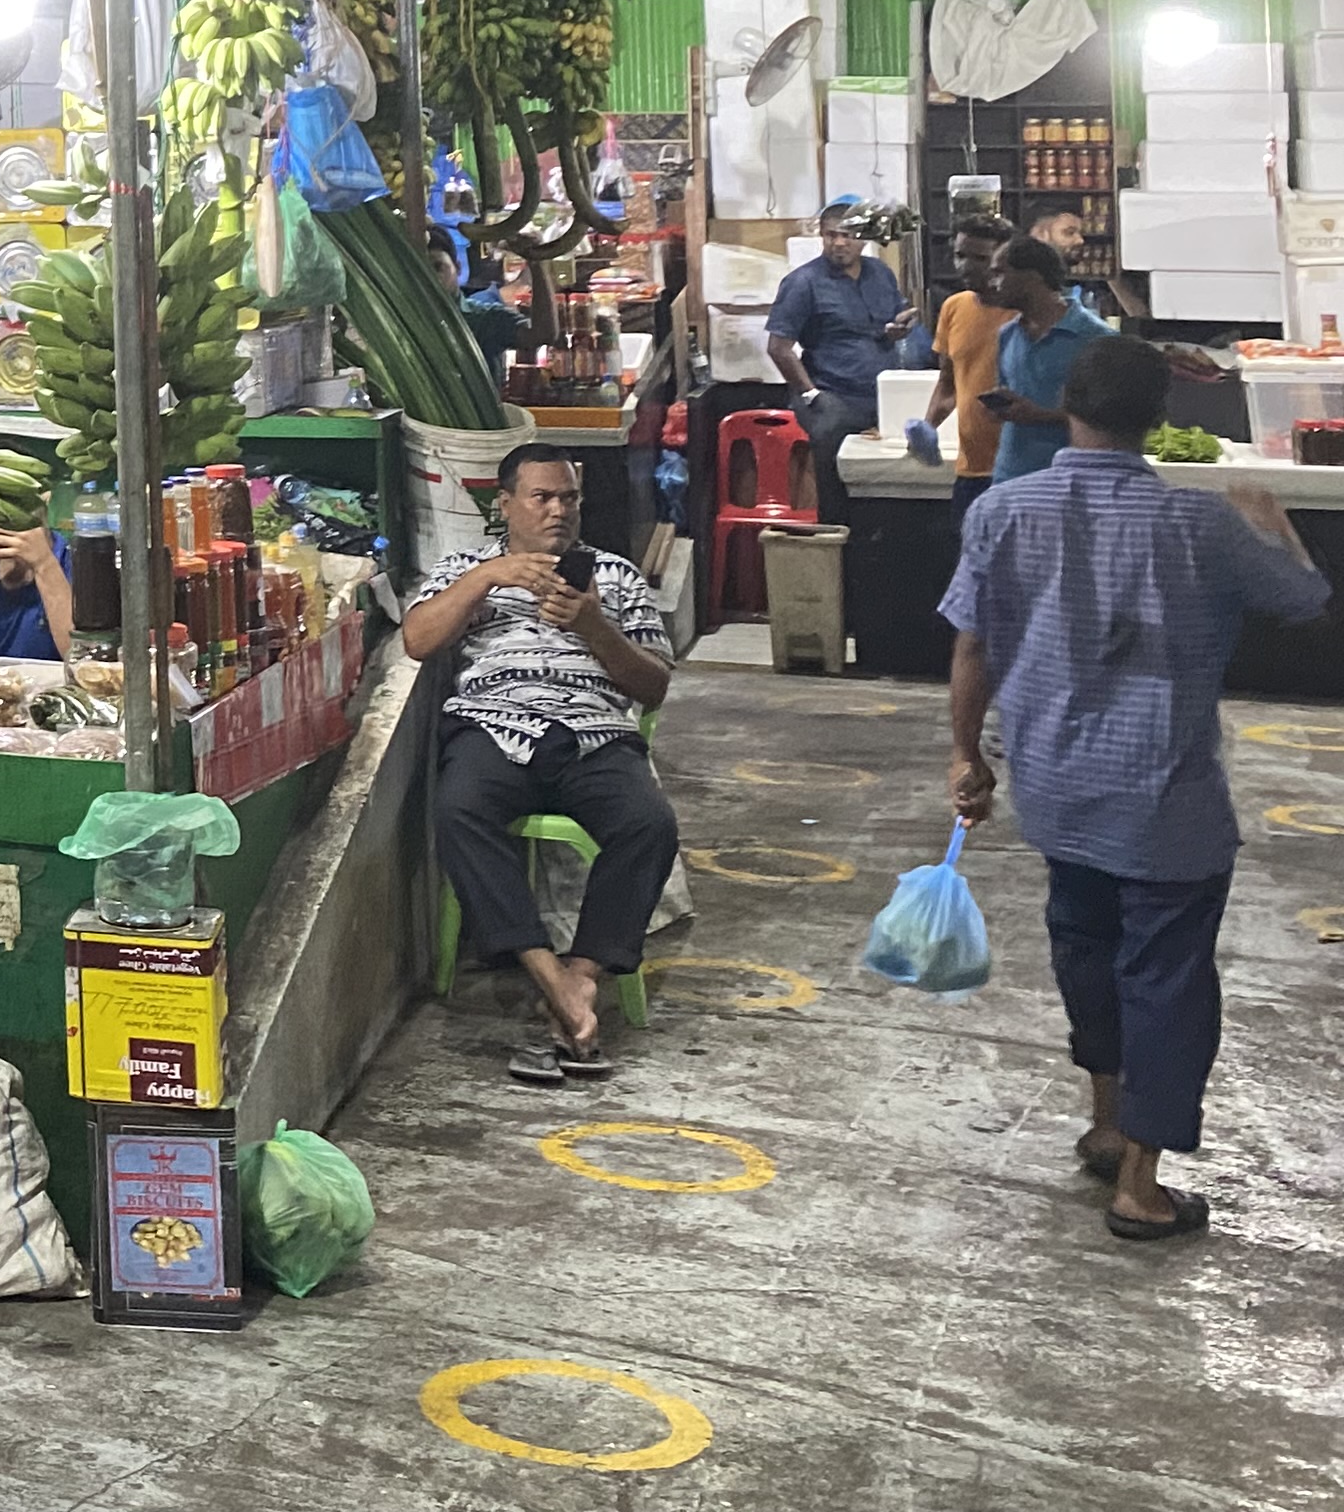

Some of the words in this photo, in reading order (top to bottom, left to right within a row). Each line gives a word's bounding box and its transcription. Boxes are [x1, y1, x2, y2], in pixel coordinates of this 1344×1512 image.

[117, 959, 147, 970] Ghee
[148, 961, 202, 975] Vegetable
[117, 1053, 182, 1079] Family
[146, 1081, 212, 1107] Happy
[151, 1159, 174, 1174] JK
[144, 1182, 182, 1194] GEM
[126, 1194, 205, 1209] BISCUITS
